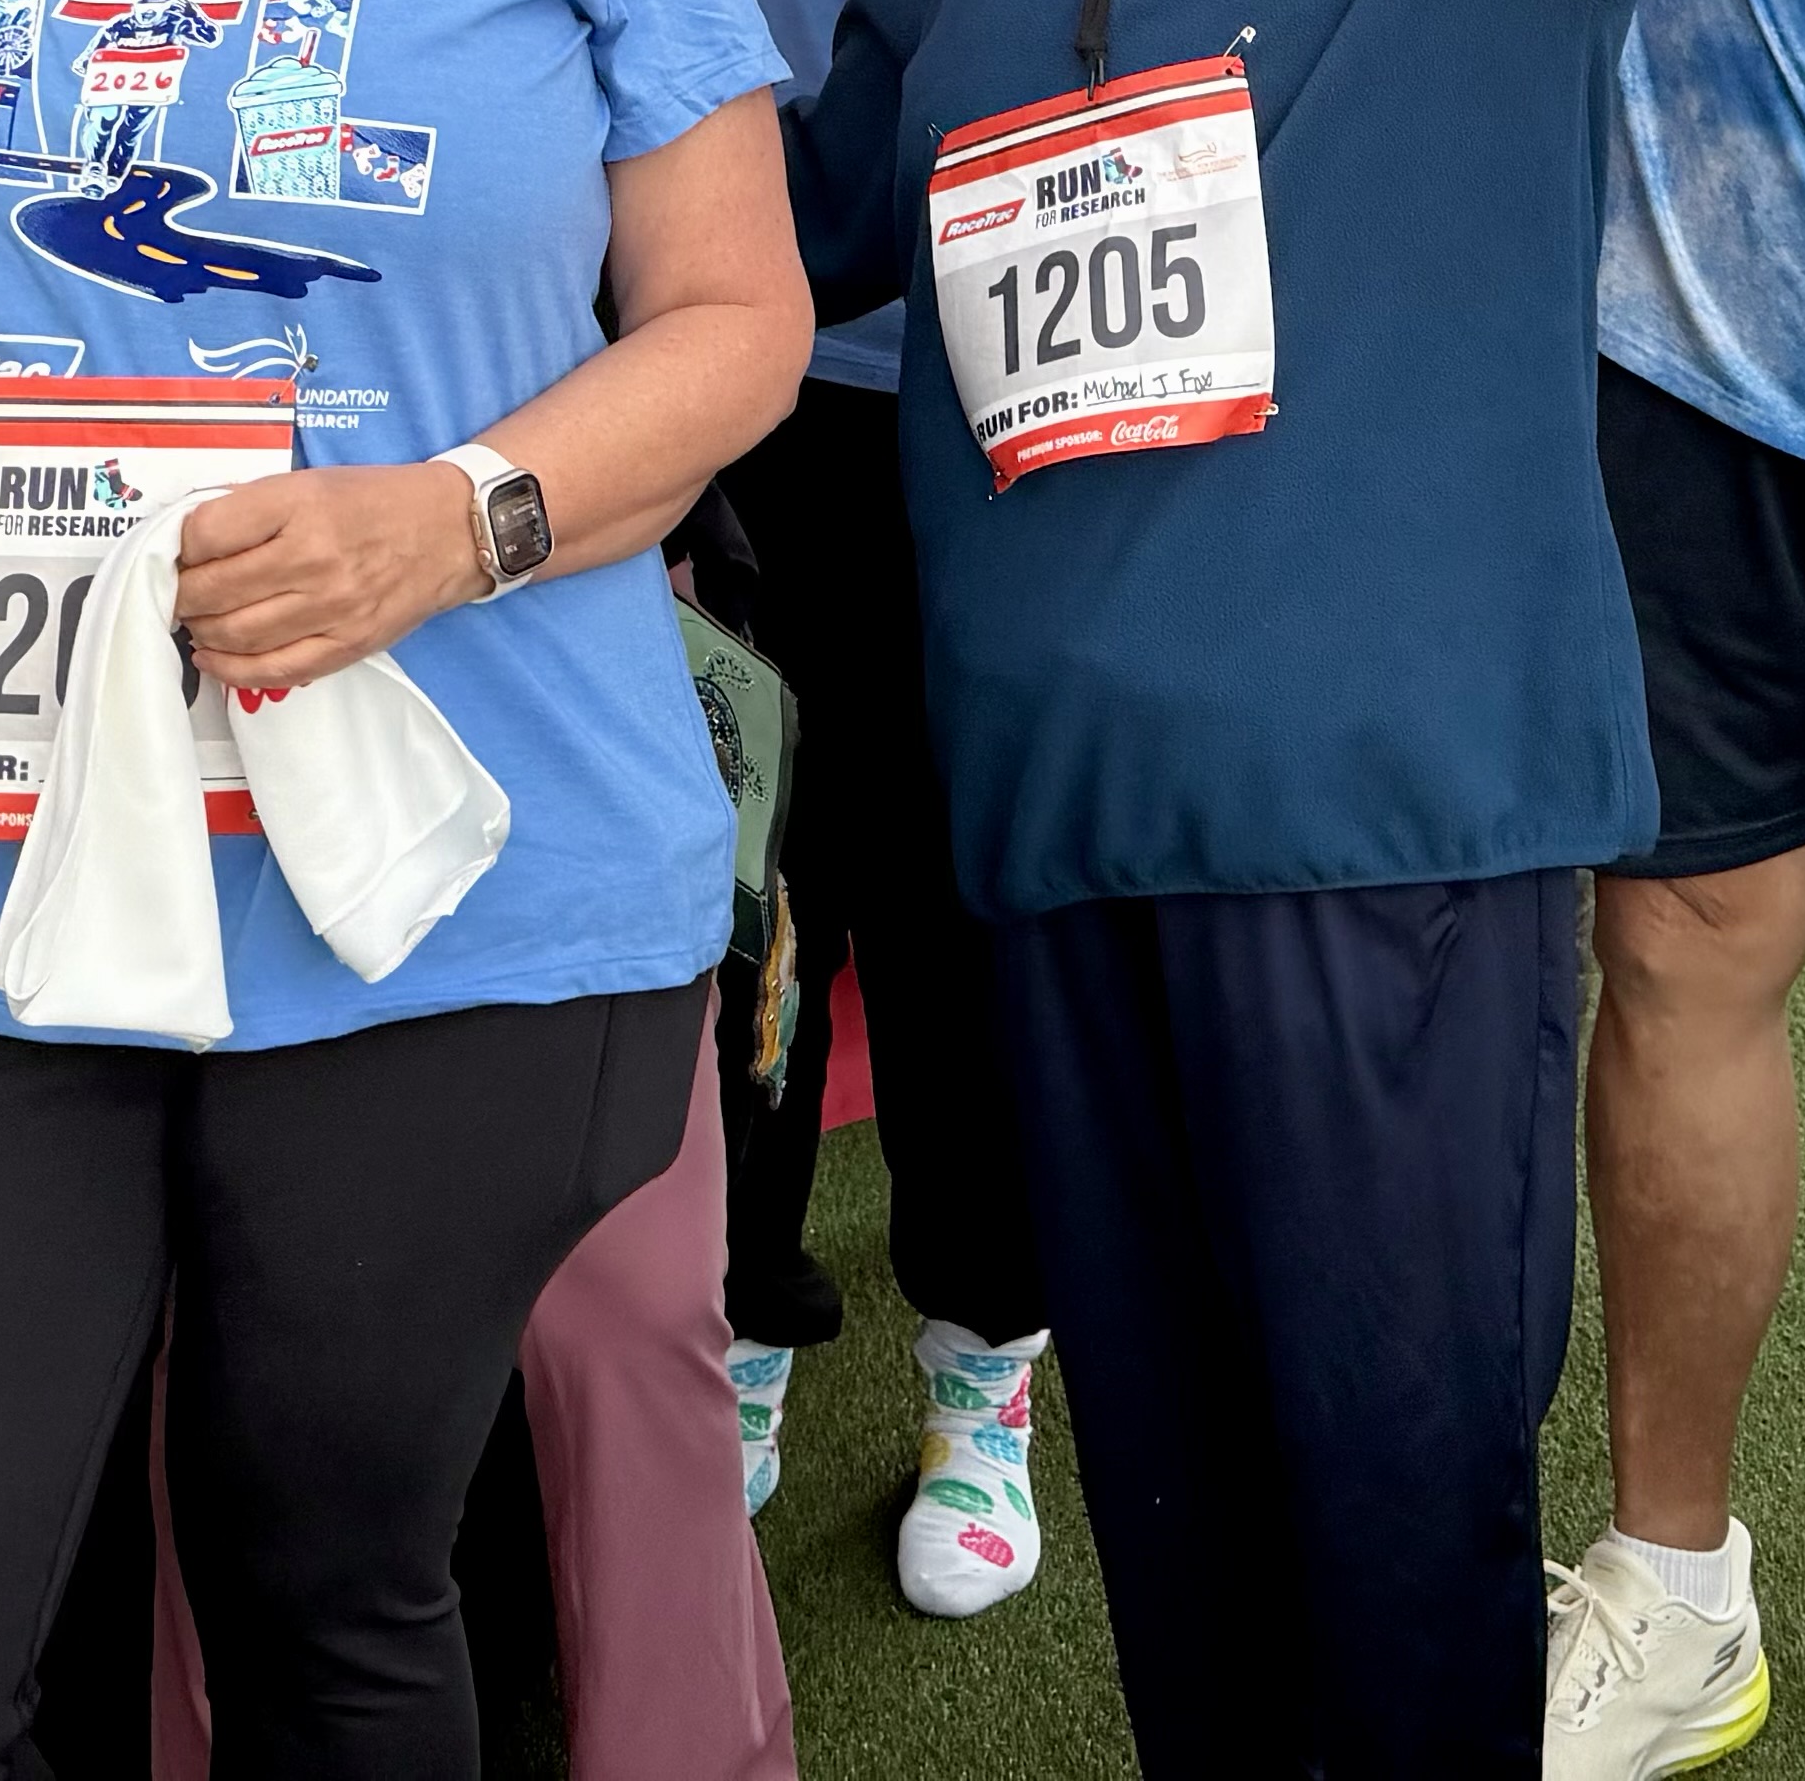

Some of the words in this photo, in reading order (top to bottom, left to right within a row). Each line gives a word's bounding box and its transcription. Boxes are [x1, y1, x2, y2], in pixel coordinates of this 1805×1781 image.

[90, 71, 173, 92] 2026
[1036, 159, 1101, 210] RUN
[946, 206, 1015, 238] RaceTrac
[1035, 210, 1057, 229] FOR
[1061, 188, 1145, 222] RESEARCH
[988, 223, 1206, 376] 1205
[296, 388, 389, 406] UNDATION
[1084, 373, 1143, 400] Michael
[1153, 373, 1169, 398] J
[1179, 369, 1212, 395] Fox
[296, 414, 359, 428] SEARCH
[977, 408, 1013, 443] RUN
[1018, 391, 1079, 423] FOR:
[0, 466, 88, 510] RUN
